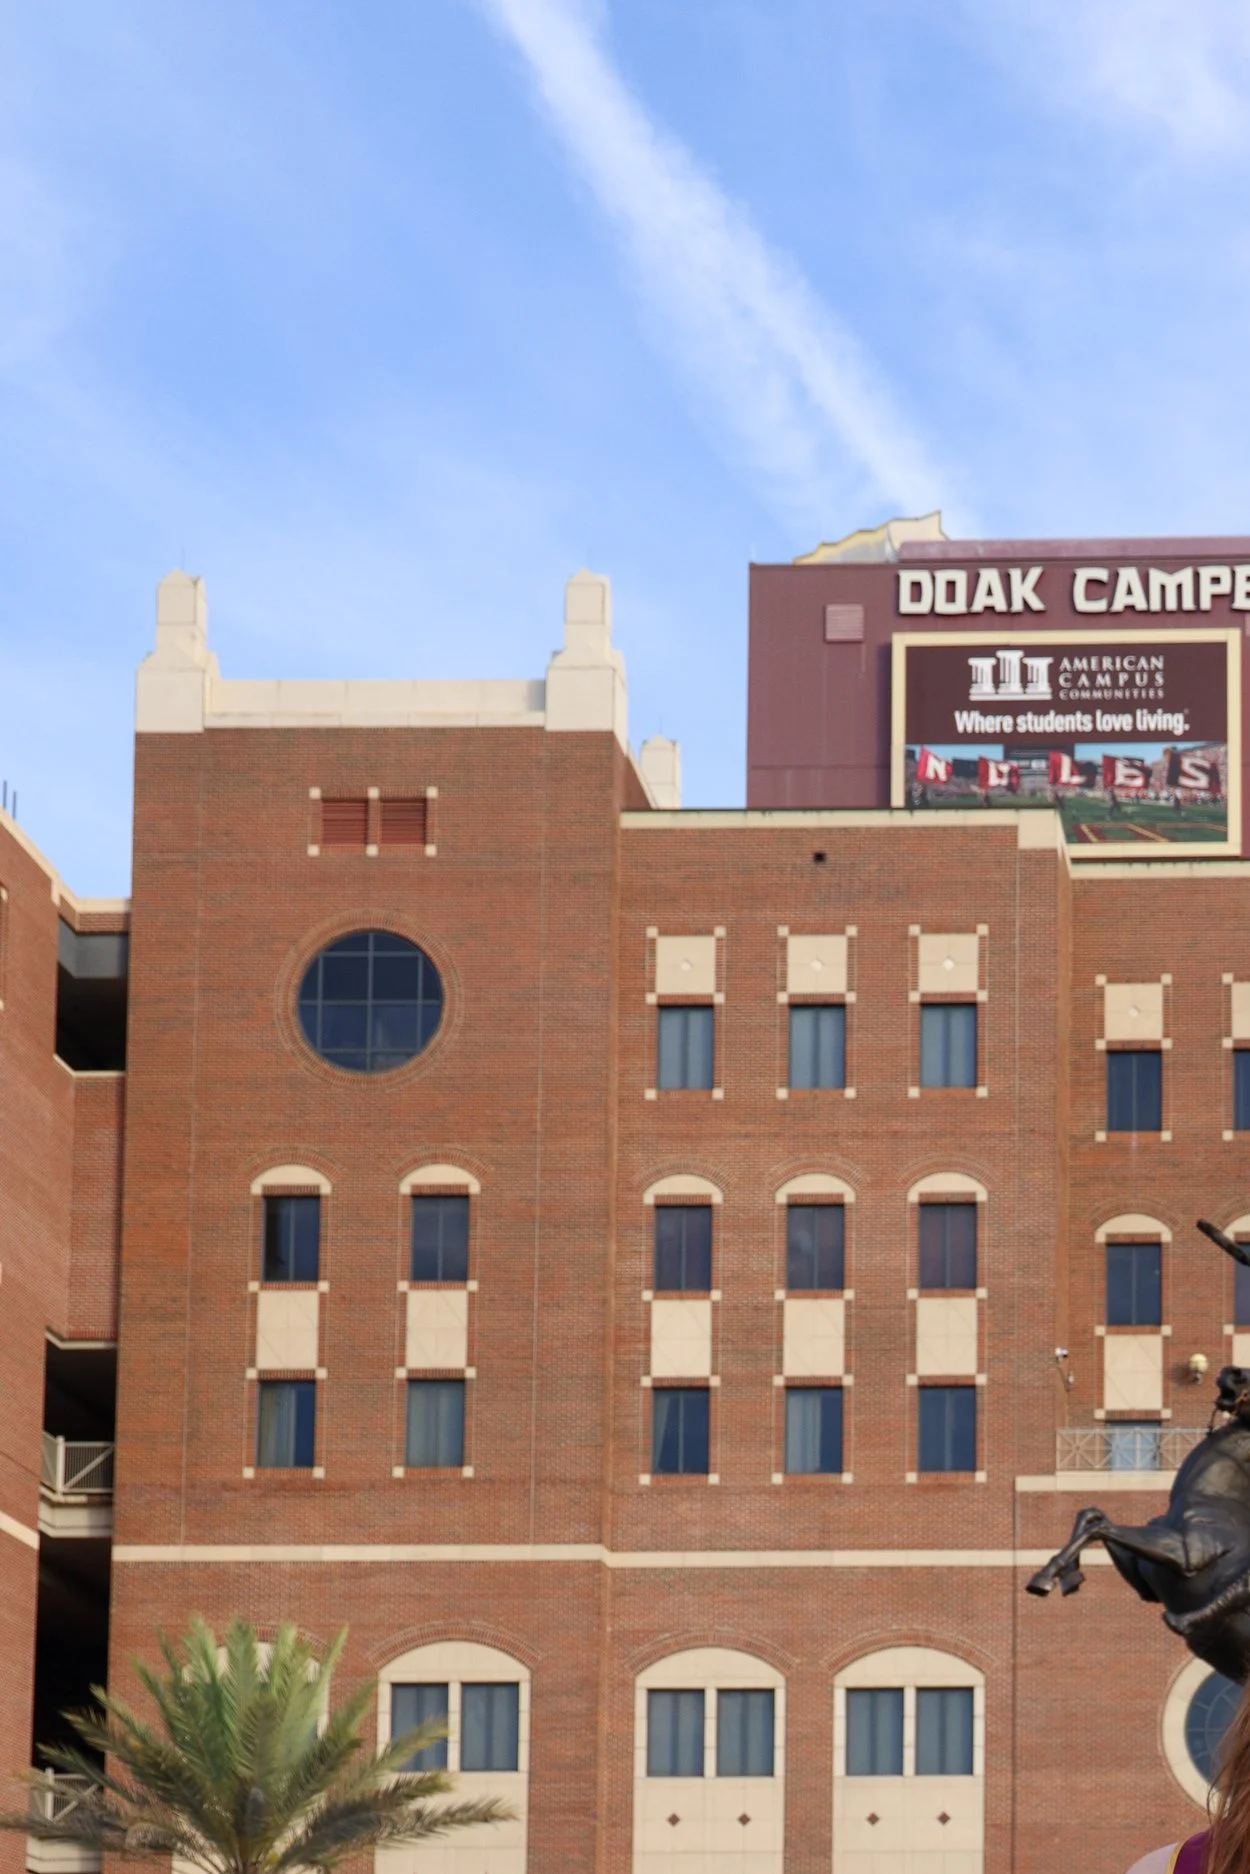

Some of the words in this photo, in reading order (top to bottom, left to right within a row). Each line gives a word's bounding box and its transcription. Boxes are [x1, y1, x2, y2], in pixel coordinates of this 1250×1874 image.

[898, 567, 1046, 615] DOAK
[1059, 655, 1164, 672] AMERICAN
[1059, 671, 1164, 688] CAMPUS
[1059, 688, 1164, 700] COMMUNITIES
[954, 710, 1013, 733] Where
[1016, 710, 1092, 733] students
[1096, 709, 1133, 732] love
[1136, 708, 1190, 736] living.
